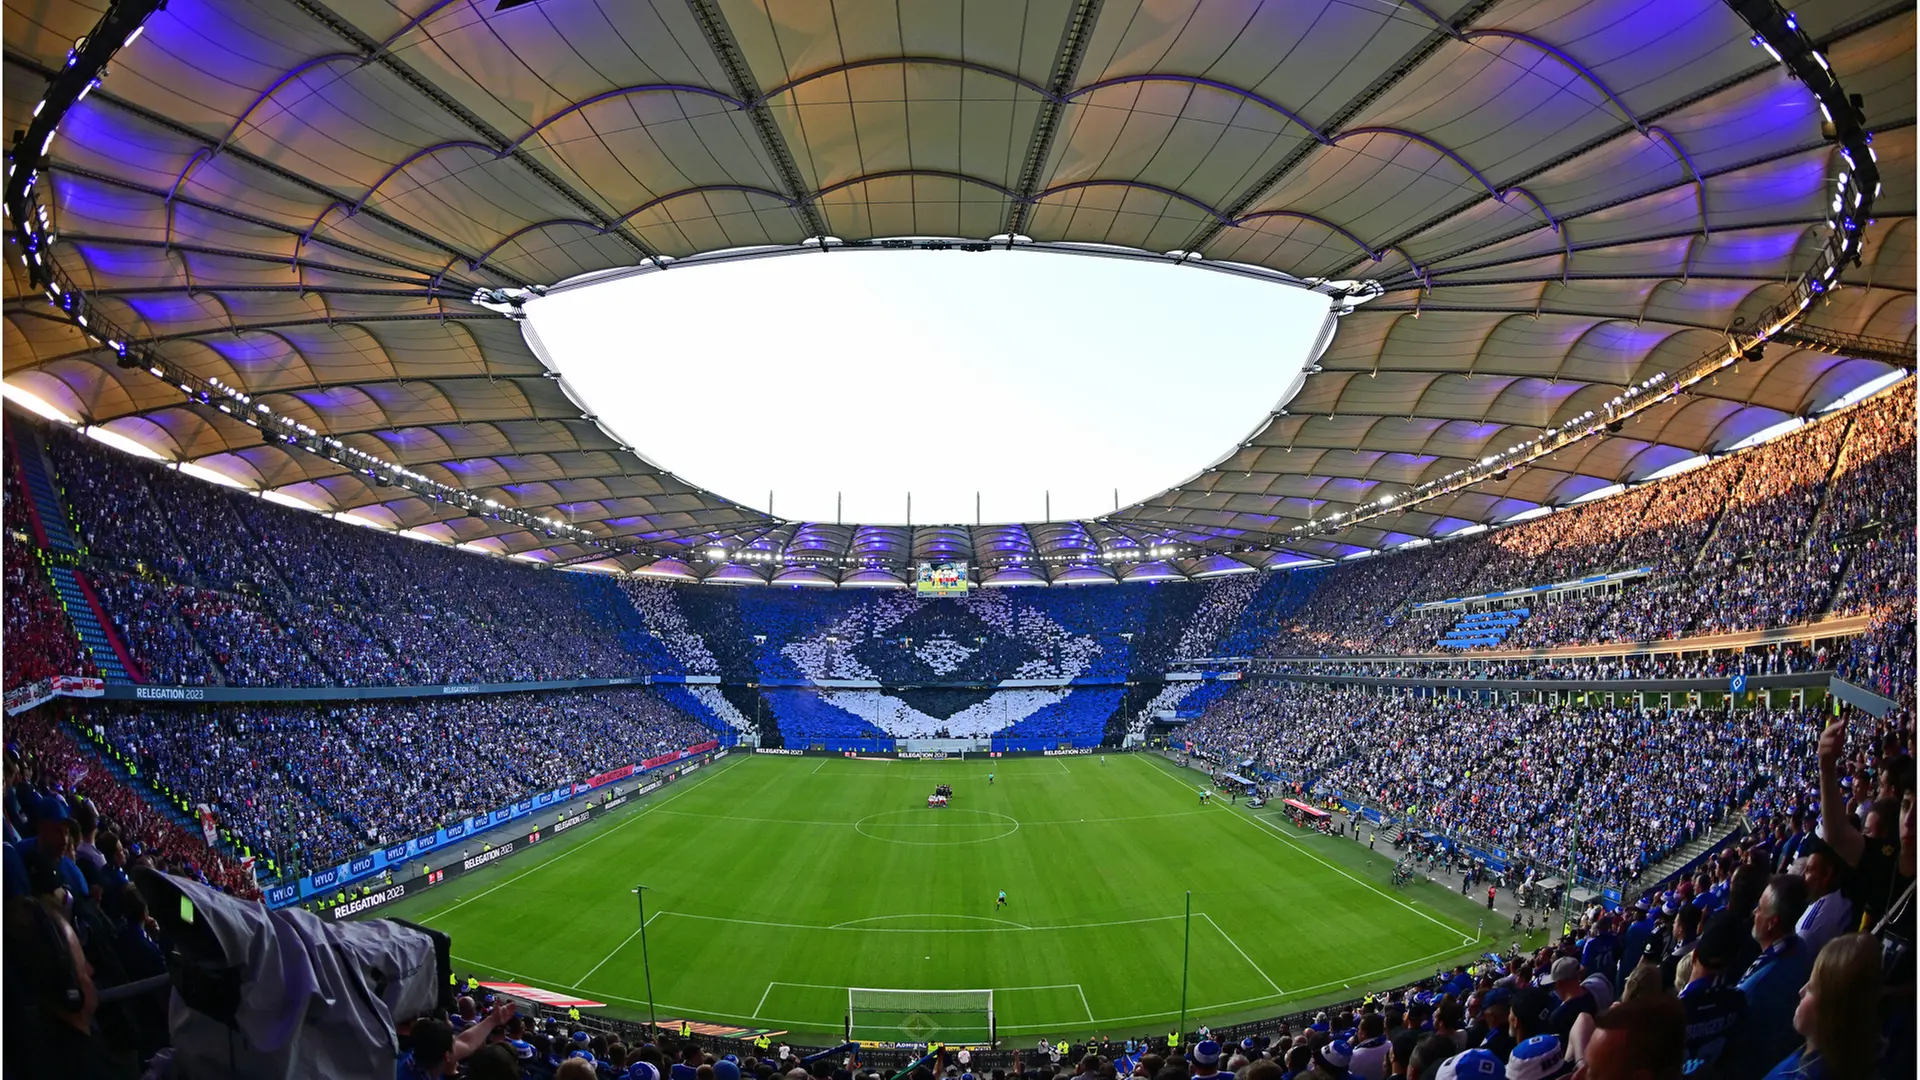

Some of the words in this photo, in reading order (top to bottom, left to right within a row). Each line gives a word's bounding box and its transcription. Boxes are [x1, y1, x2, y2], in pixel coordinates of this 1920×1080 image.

[136, 688, 184, 699] RELEGATION
[185, 690, 203, 699] 2023
[448, 826, 462, 838] HYLO
[420, 835, 434, 848] HYLO
[387, 847, 404, 860] HYLO
[464, 848, 500, 870] RELEGATION
[500, 843, 513, 856] 2023
[353, 859, 371, 873] HYLO
[314, 872, 334, 887] HYLO
[272, 885, 294, 902] HYLO
[334, 892, 386, 919] RELEGATION
[386, 884, 405, 901] 2023
